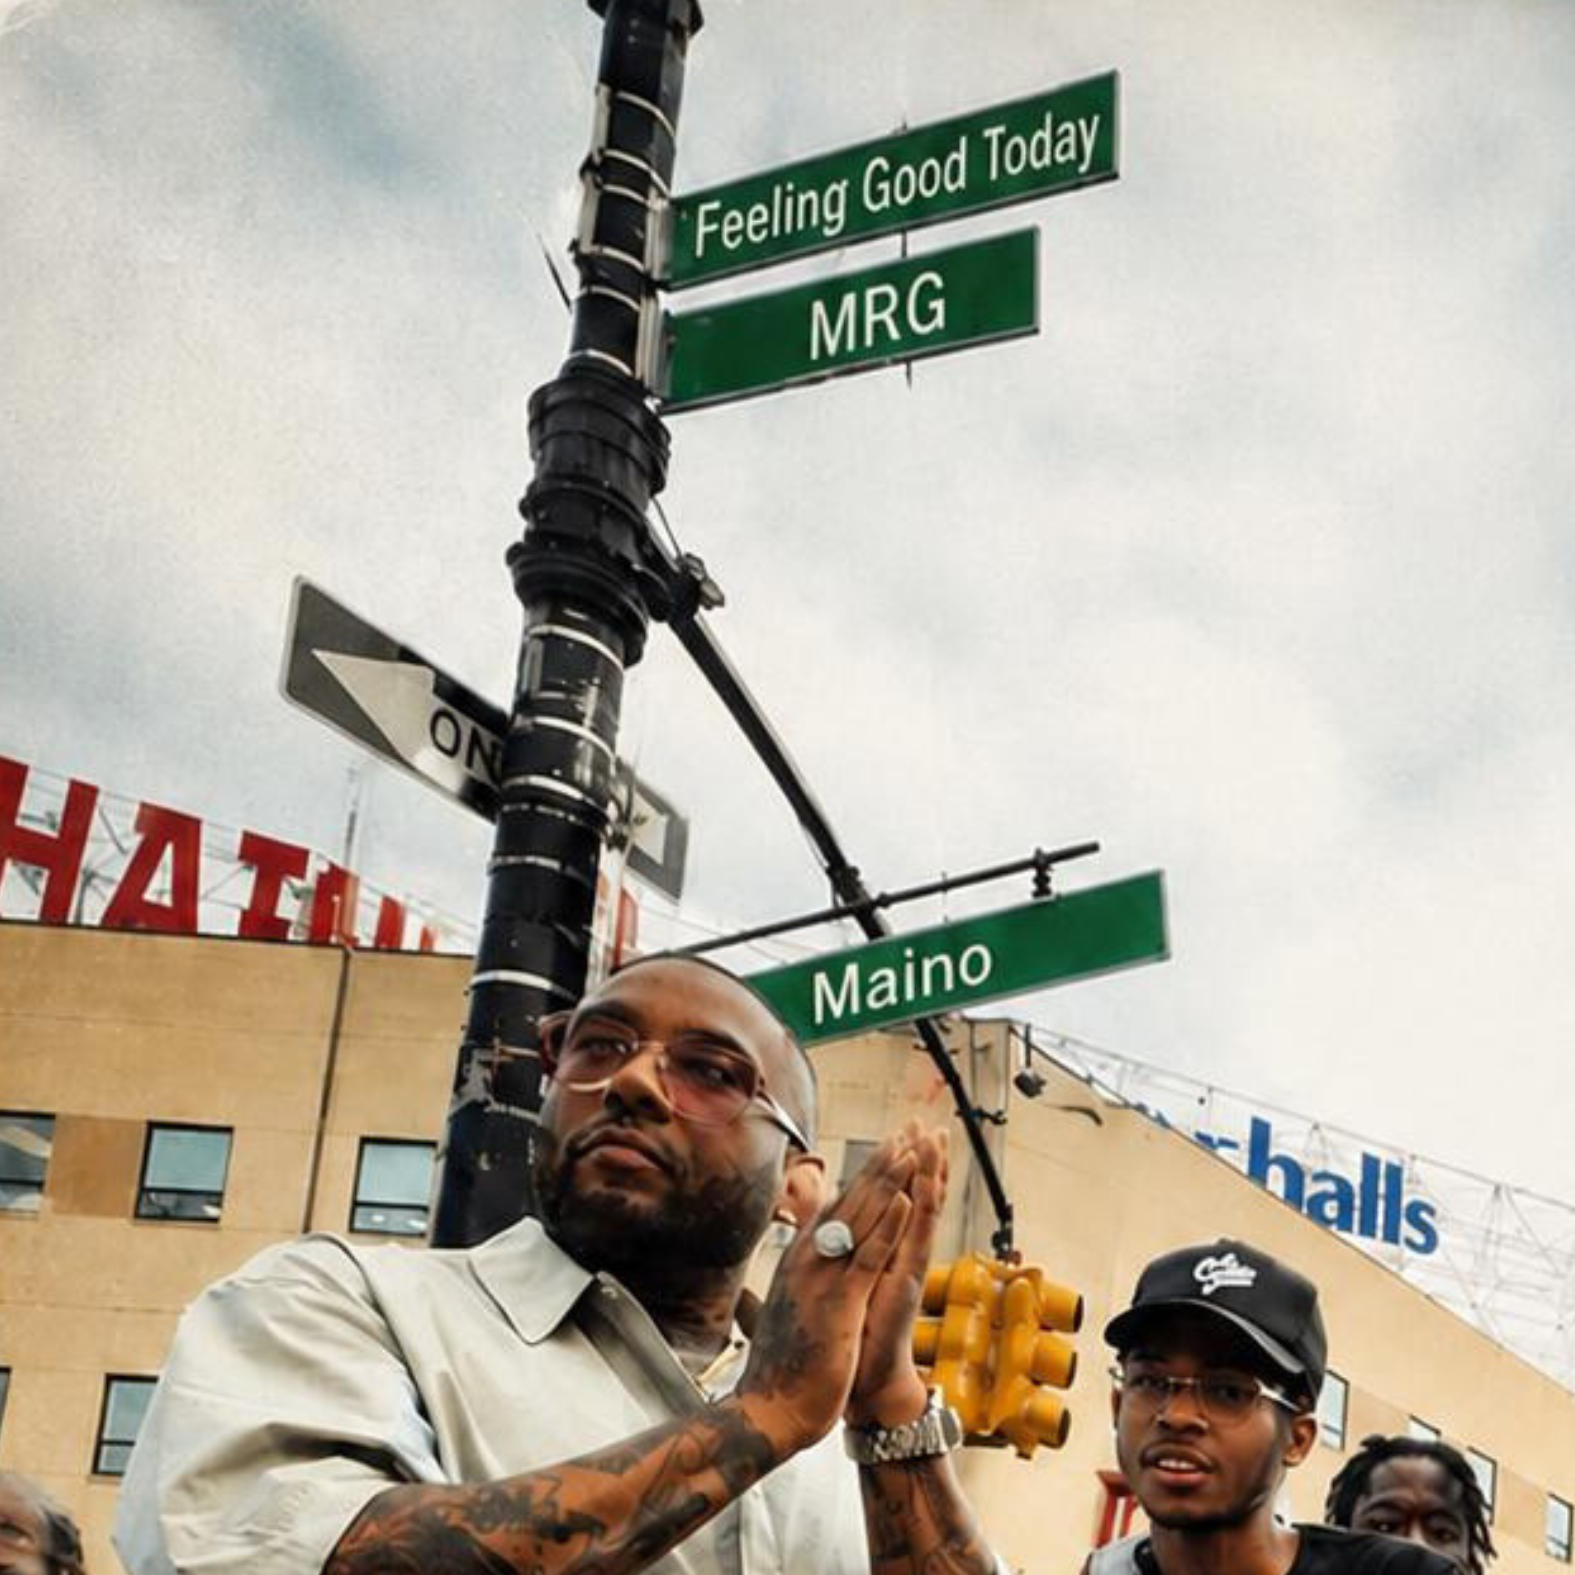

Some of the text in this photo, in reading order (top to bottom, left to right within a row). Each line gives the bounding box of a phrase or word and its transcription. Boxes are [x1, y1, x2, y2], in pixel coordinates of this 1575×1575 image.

[694, 111, 1100, 258] Feeling Good Today
[809, 271, 946, 360] MRG
[812, 940, 993, 1025] Maino
